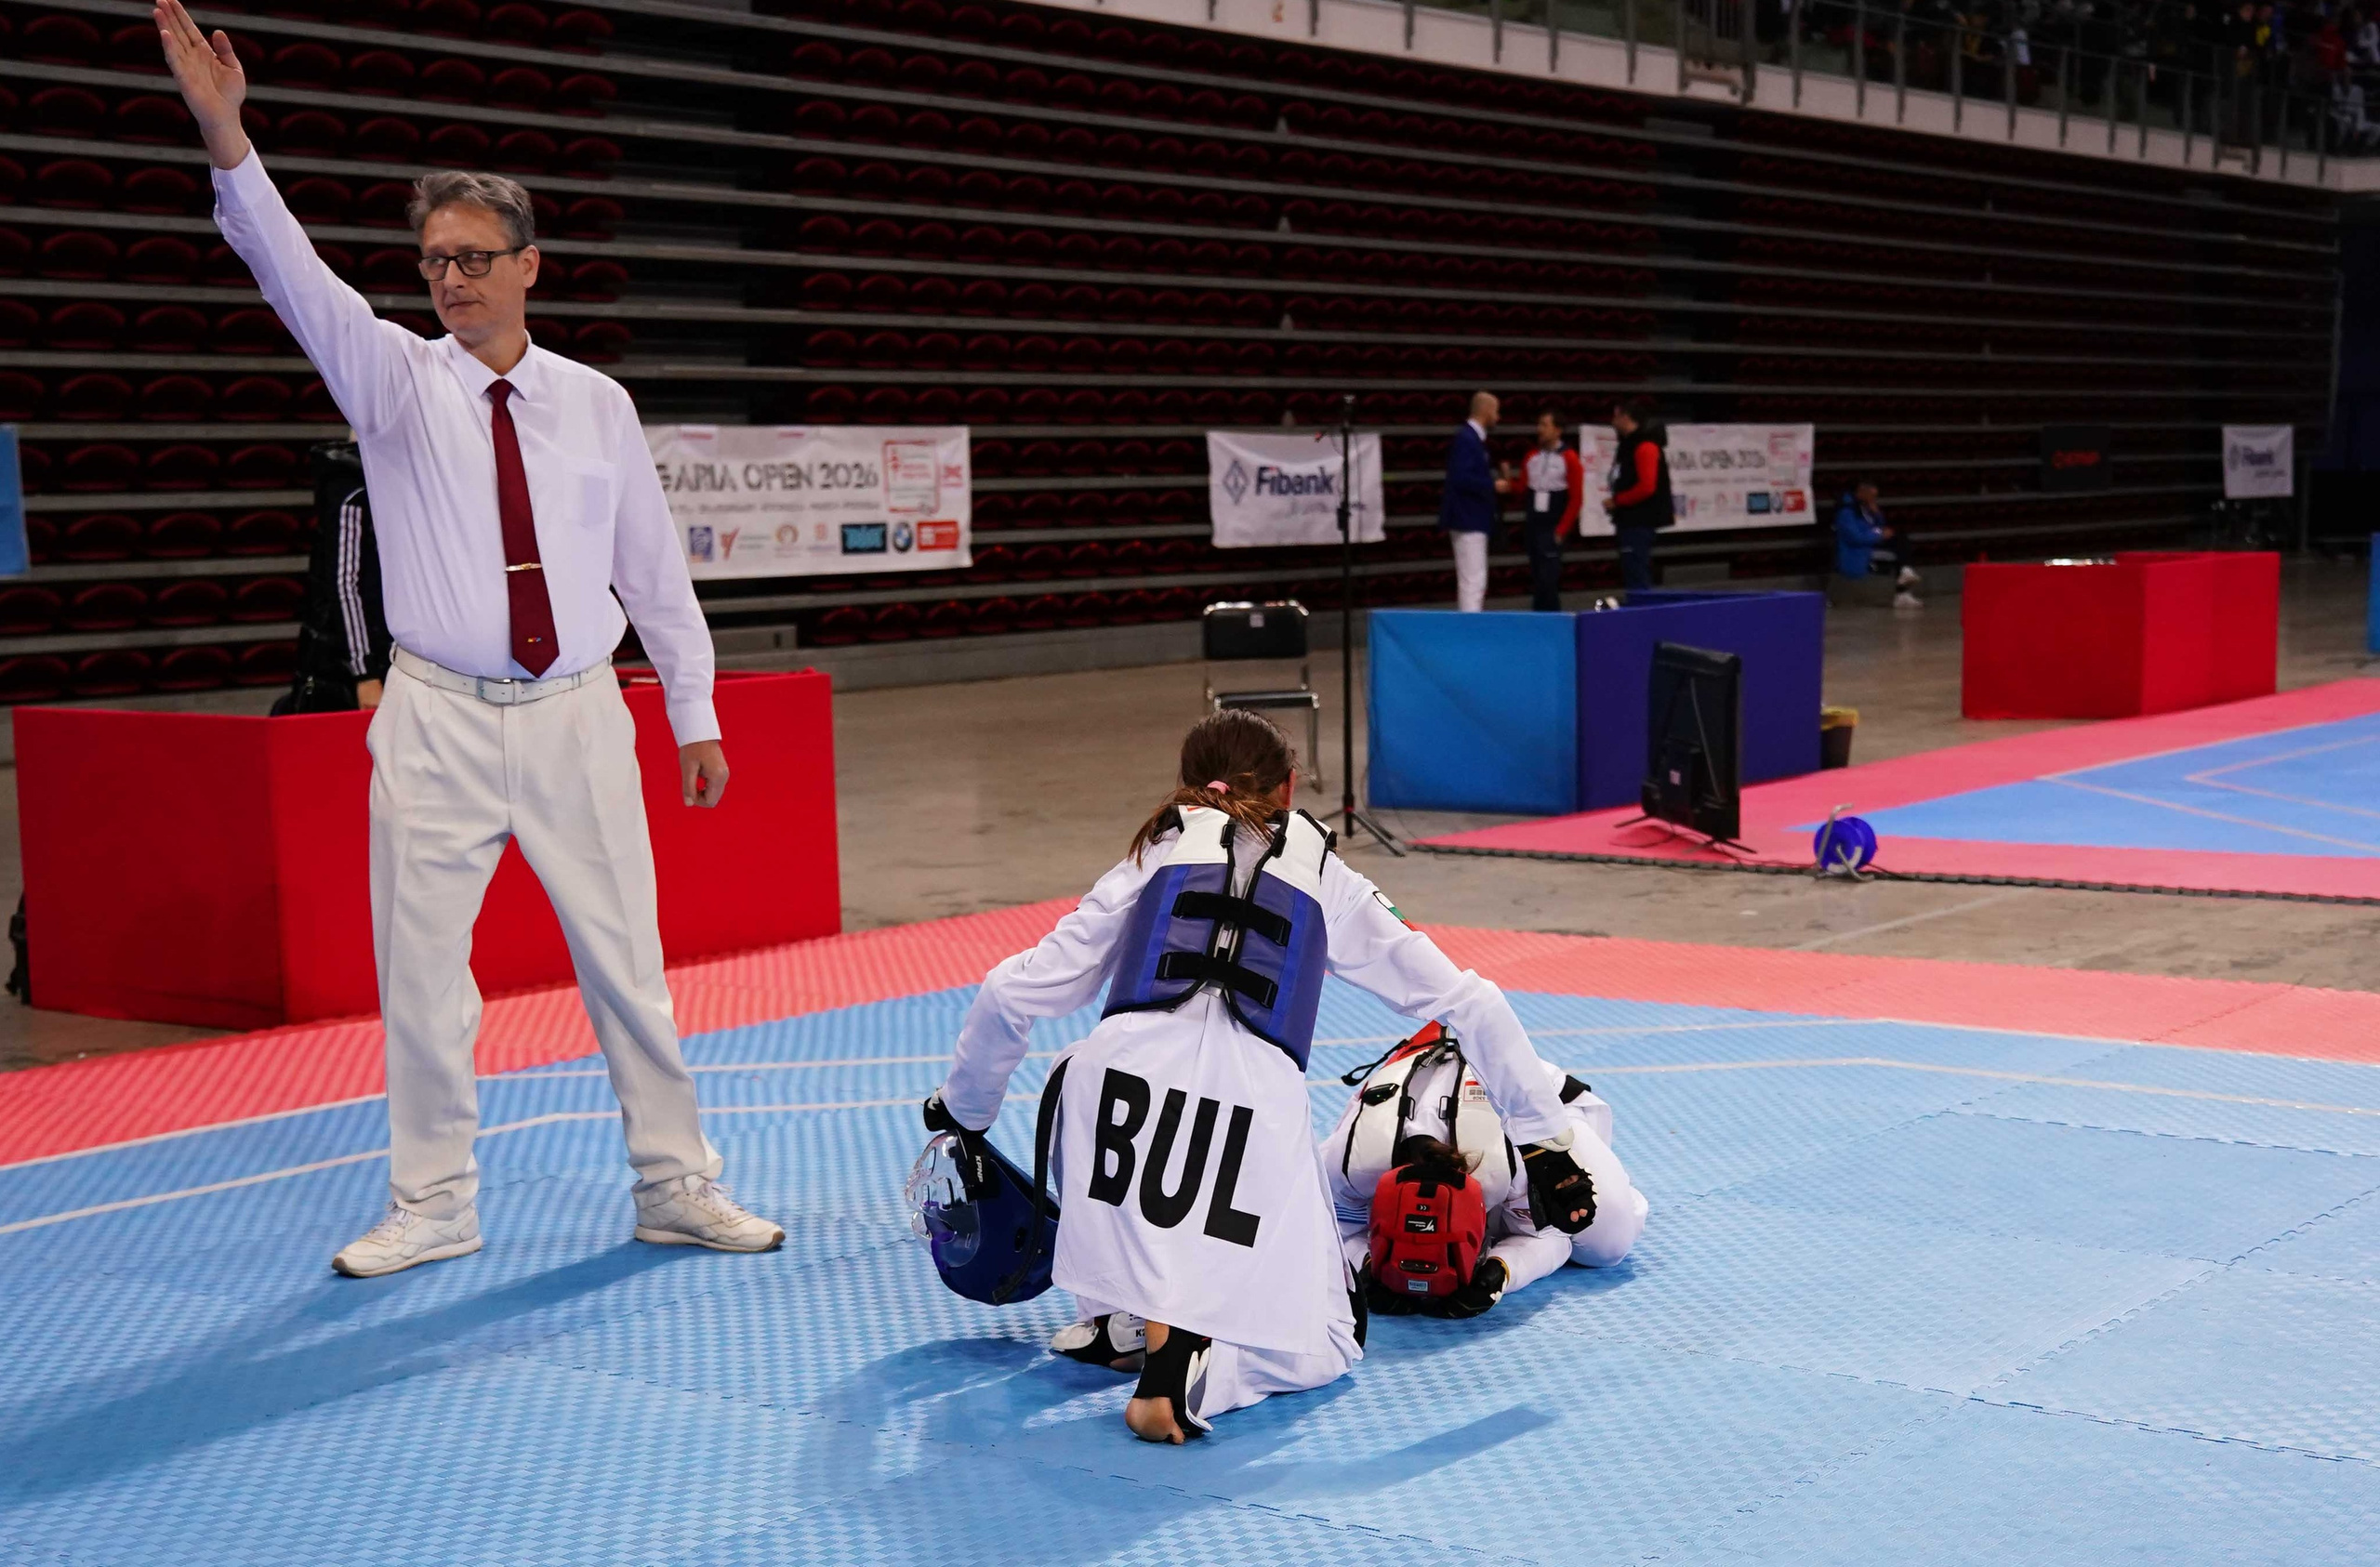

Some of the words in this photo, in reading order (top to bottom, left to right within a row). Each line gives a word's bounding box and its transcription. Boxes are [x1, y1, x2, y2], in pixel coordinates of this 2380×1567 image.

[744, 464, 813, 492] OPEN
[820, 463, 879, 490] 2026
[1256, 466, 1335, 496] Fibank
[1088, 1067, 1261, 1247] BUL
